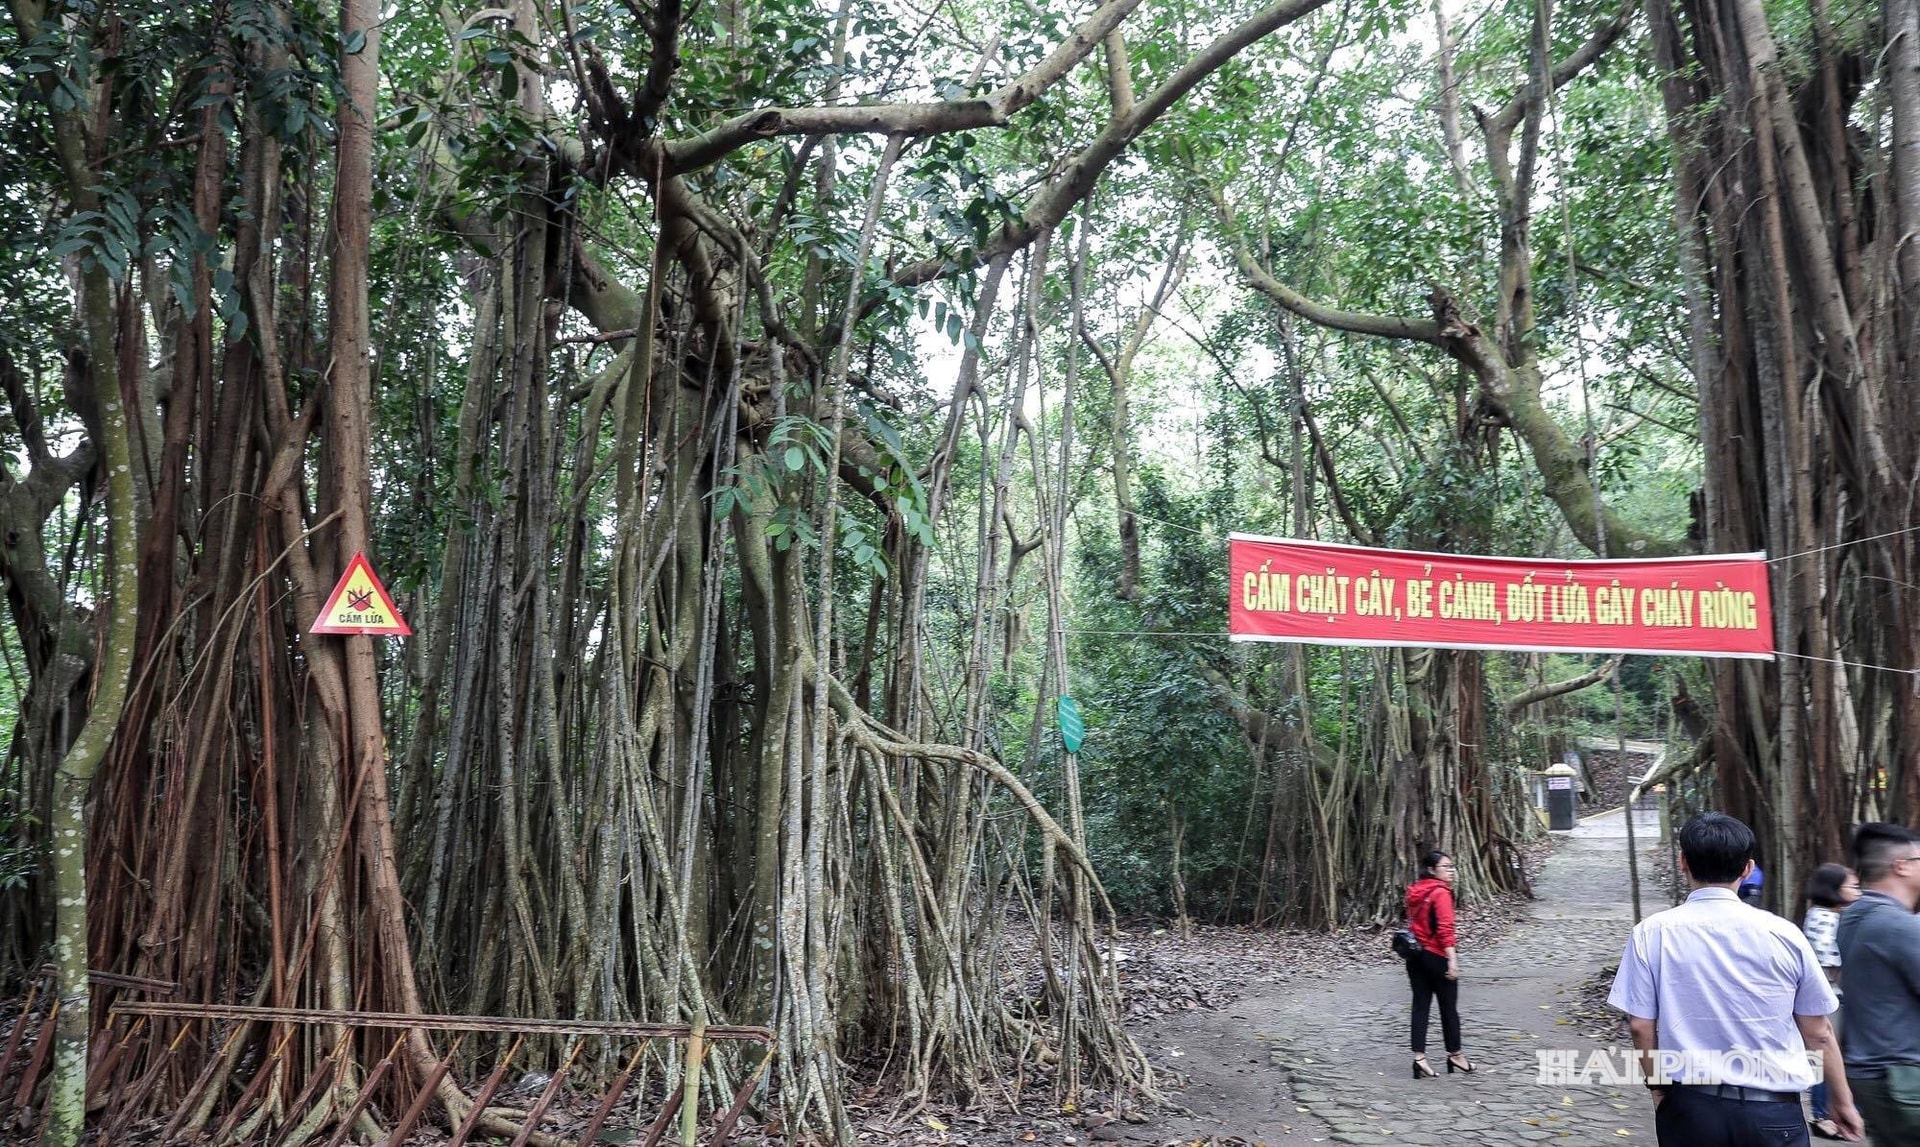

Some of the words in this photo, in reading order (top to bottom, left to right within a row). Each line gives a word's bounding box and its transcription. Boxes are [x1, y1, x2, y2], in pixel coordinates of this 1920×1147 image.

[1243, 559, 1291, 613] CẤM
[1296, 568, 1350, 623] CHẶT
[1354, 569, 1401, 622] CÂY,
[1406, 563, 1434, 619] BẺ
[1438, 572, 1502, 626] CÀNH,
[1506, 570, 1547, 622] ĐỐT
[1551, 569, 1591, 624] LỬA
[1595, 579, 1635, 626] GÂY
[1640, 581, 1694, 628] CHÁY
[1698, 581, 1758, 630] RỪNG
